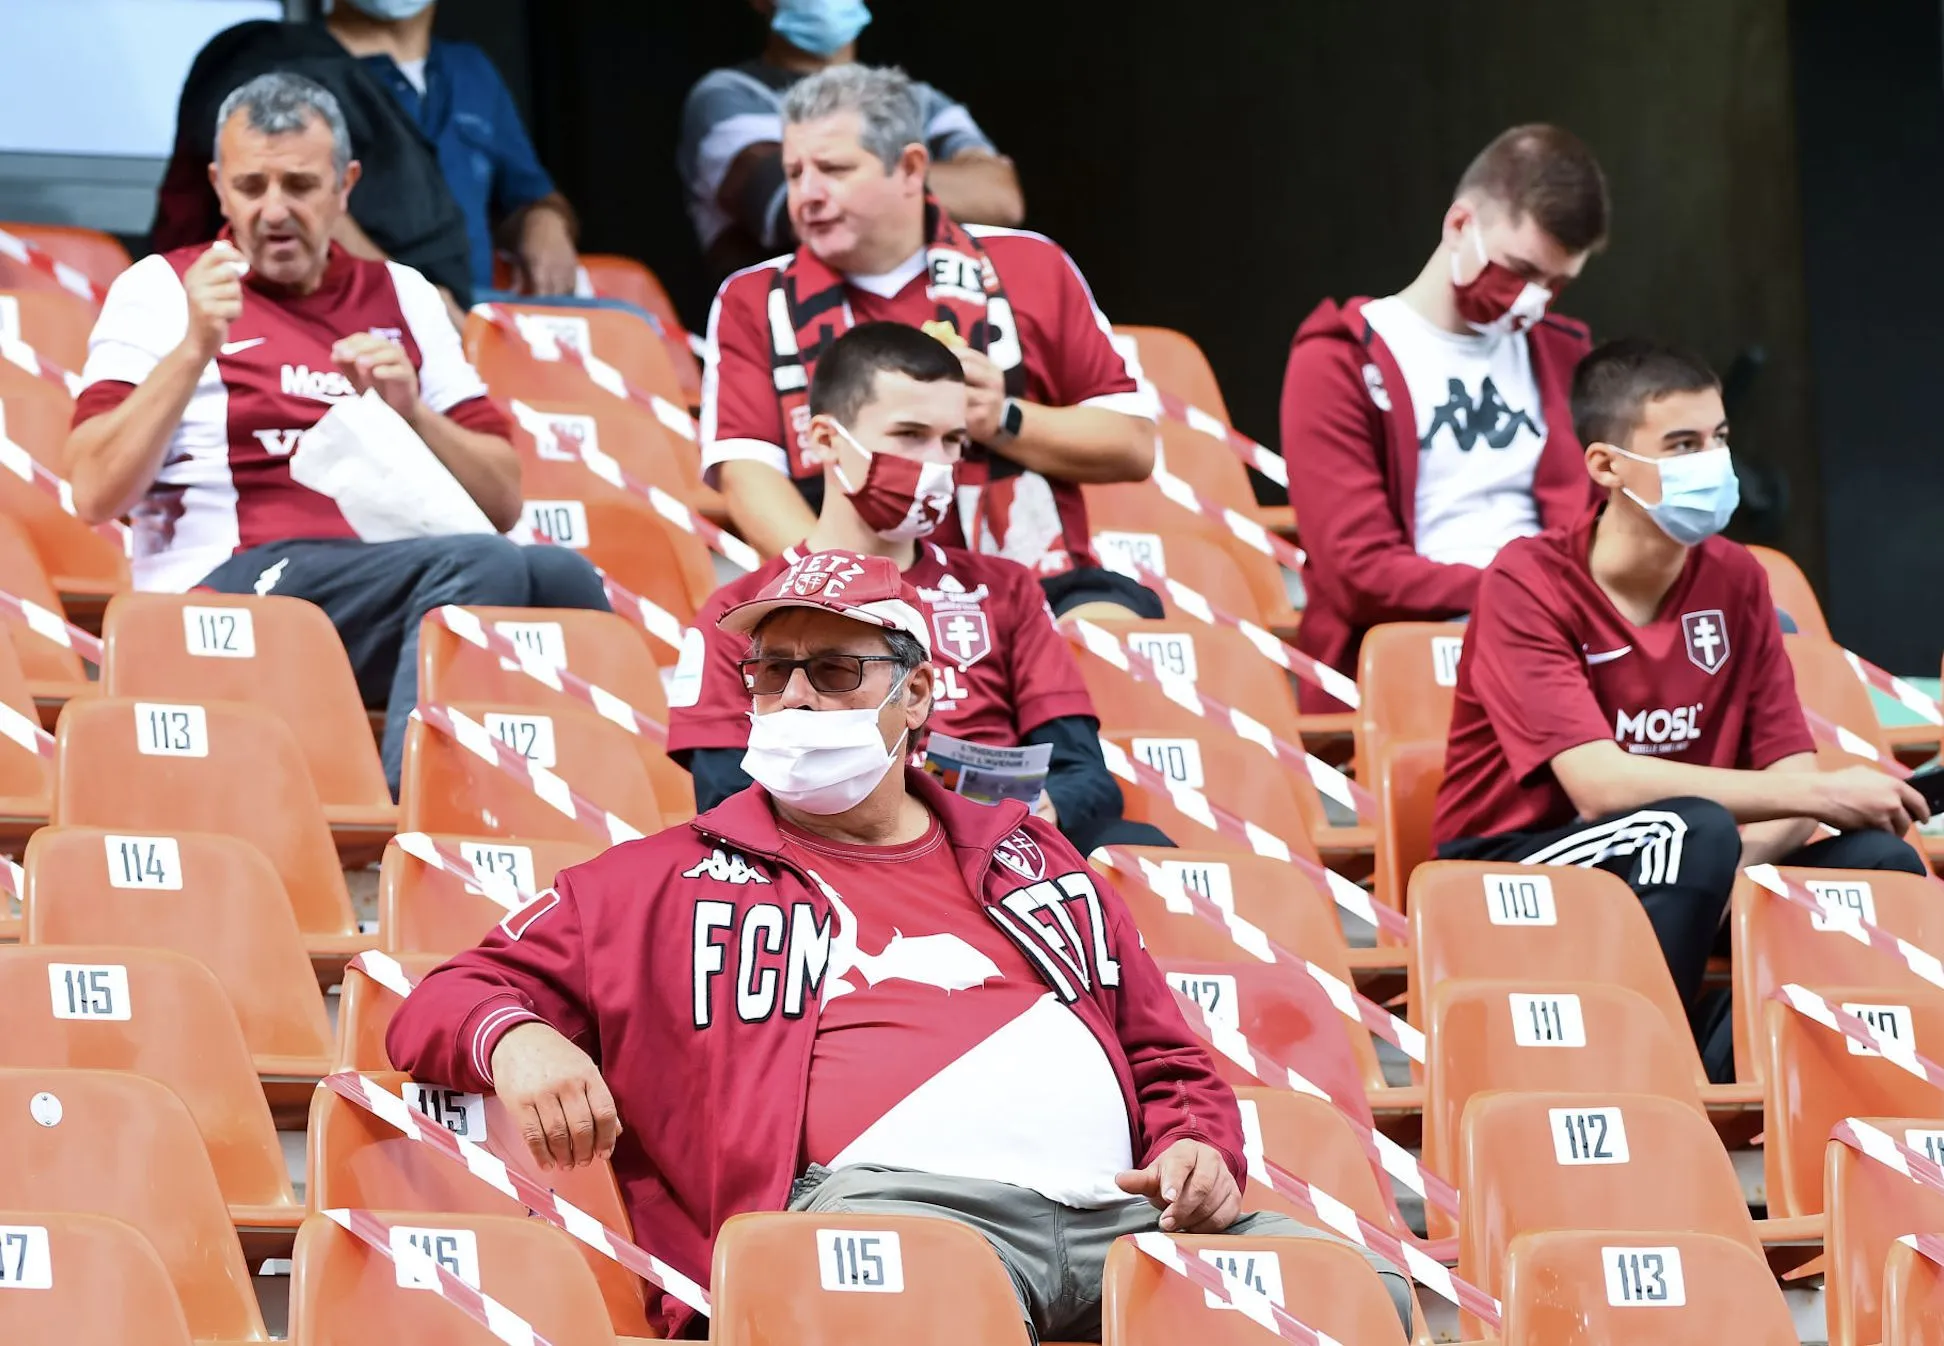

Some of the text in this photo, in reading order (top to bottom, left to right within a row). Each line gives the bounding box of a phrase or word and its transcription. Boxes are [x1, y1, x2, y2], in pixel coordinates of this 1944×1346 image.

[786, 554, 865, 582] METZ
[199, 615, 238, 649] 112
[1137, 640, 1185, 676] 09
[150, 711, 191, 749] 113
[1615, 705, 1701, 743] MOSL
[1147, 745, 1186, 782] 110
[120, 843, 165, 883] 114
[1498, 881, 1540, 919] 110
[692, 899, 833, 1030] FCM
[64, 970, 113, 1015] 115
[1529, 1000, 1564, 1041] 111
[418, 1088, 469, 1136] 115
[1565, 1114, 1613, 1159] 112
[409, 1234, 460, 1282] 16
[833, 1236, 885, 1286] 115
[1617, 1254, 1669, 1301] 113
